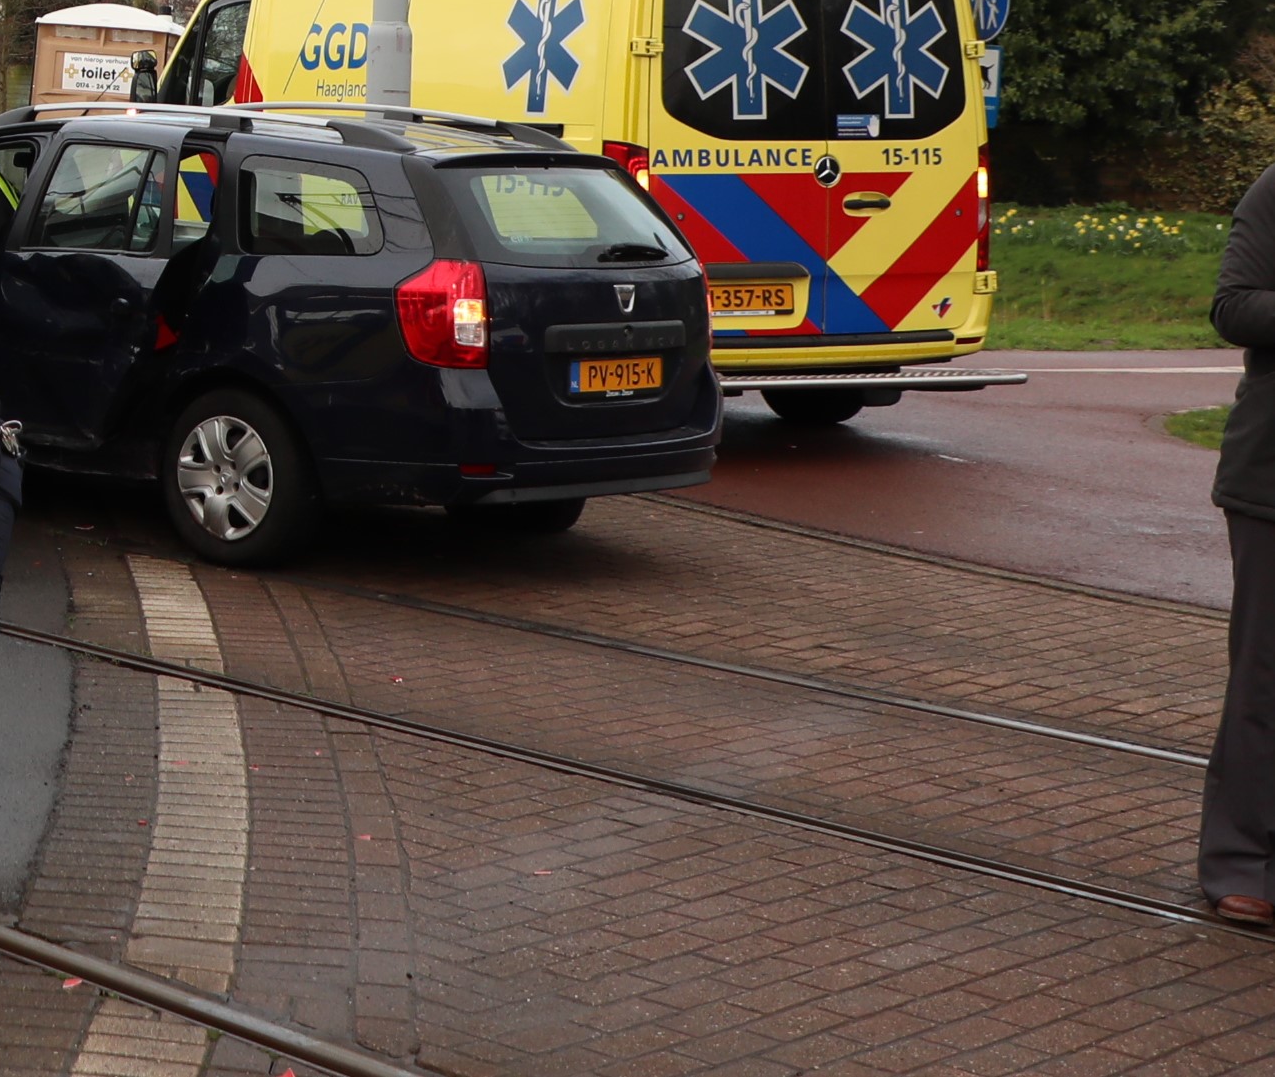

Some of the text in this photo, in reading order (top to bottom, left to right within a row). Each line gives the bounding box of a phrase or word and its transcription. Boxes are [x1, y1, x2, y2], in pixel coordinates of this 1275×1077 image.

[300, 22, 370, 71] GGD
[81, 66, 117, 81] toilet
[652, 147, 943, 168] AMBULANCE 15-115
[587, 361, 656, 388] PV-915-K
